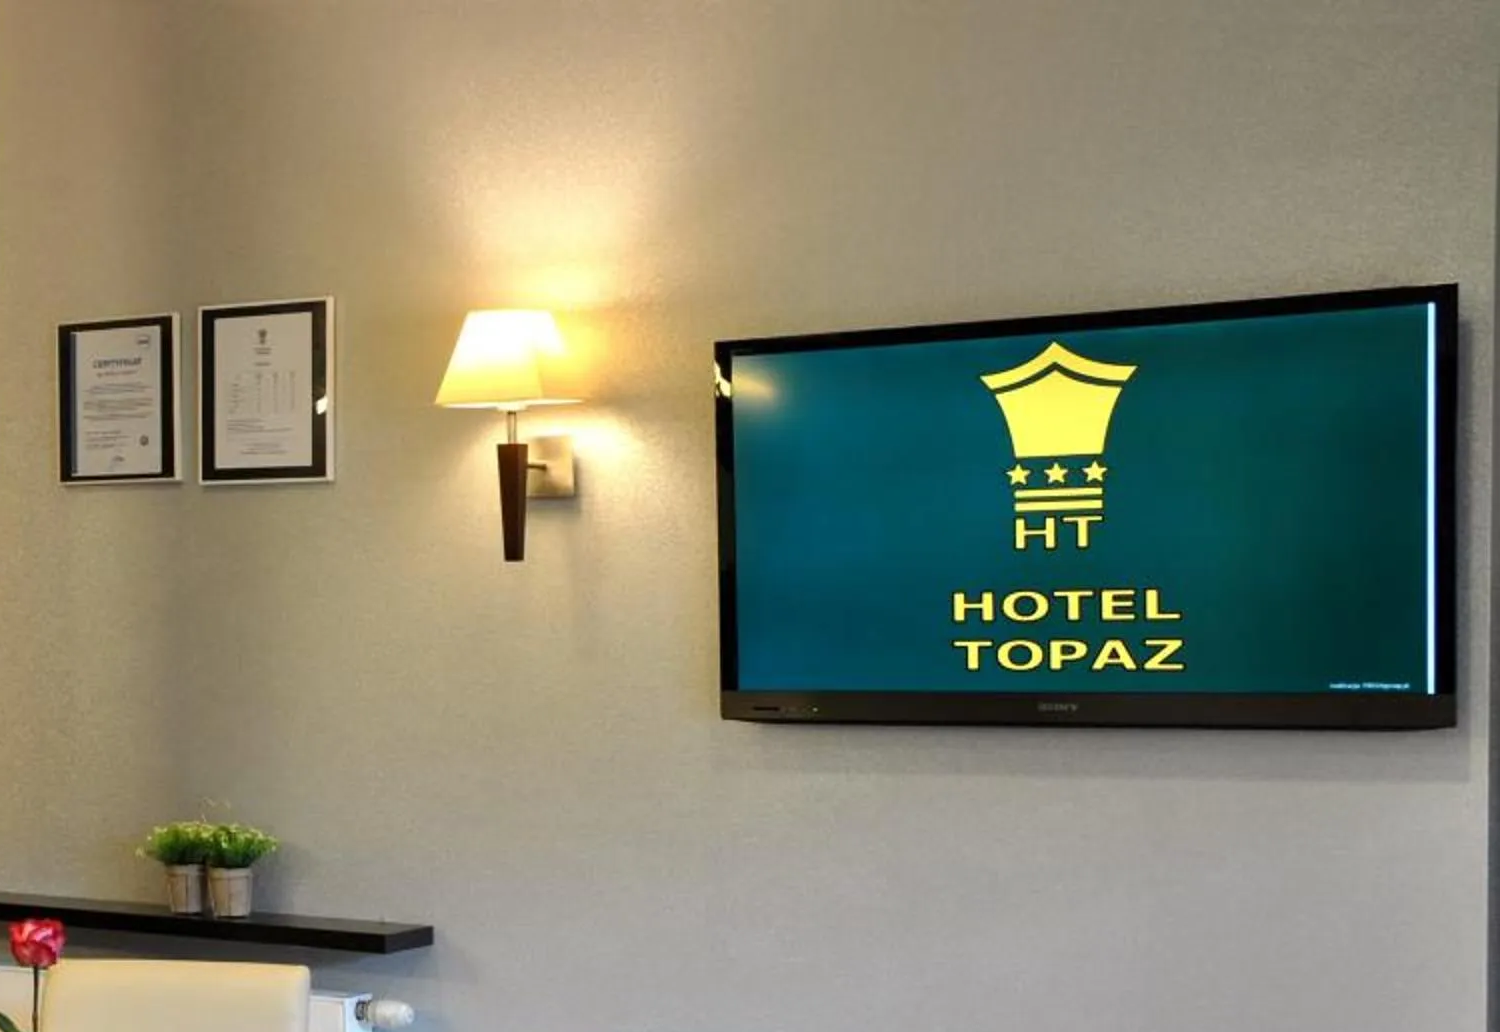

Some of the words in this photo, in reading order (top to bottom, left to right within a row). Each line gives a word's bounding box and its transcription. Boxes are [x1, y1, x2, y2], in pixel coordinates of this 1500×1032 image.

[1014, 515, 1104, 549] HT
[952, 588, 1182, 622] HOTEL
[952, 638, 1185, 671] TOPAZ
